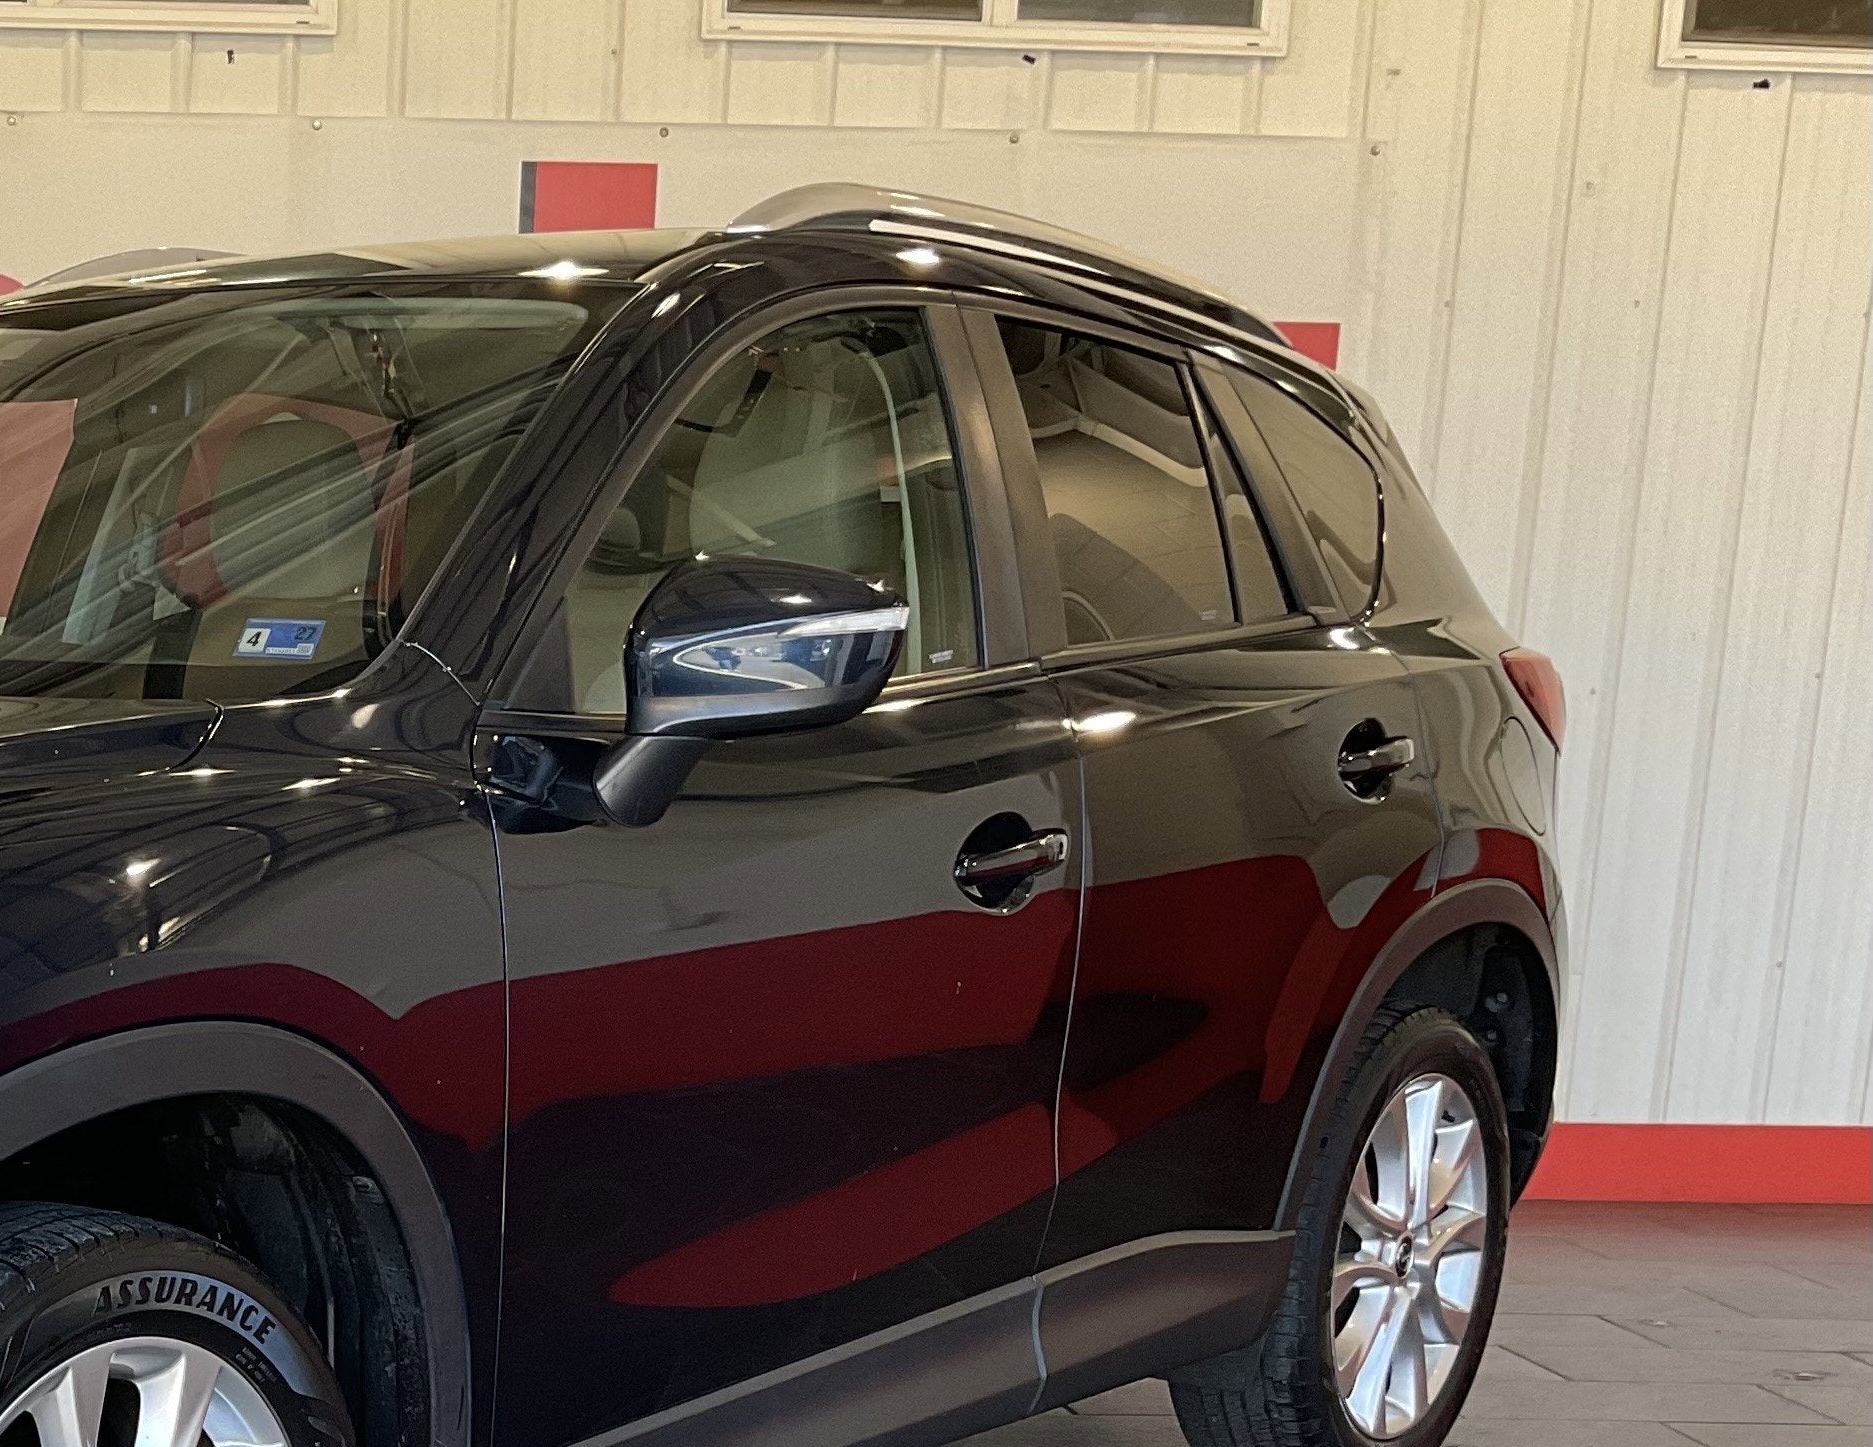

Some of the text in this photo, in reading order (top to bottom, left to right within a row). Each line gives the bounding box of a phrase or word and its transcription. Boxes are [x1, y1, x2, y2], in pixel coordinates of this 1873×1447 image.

[246, 626, 317, 647] 4 27
[93, 1276, 276, 1344] ASSURANCE
